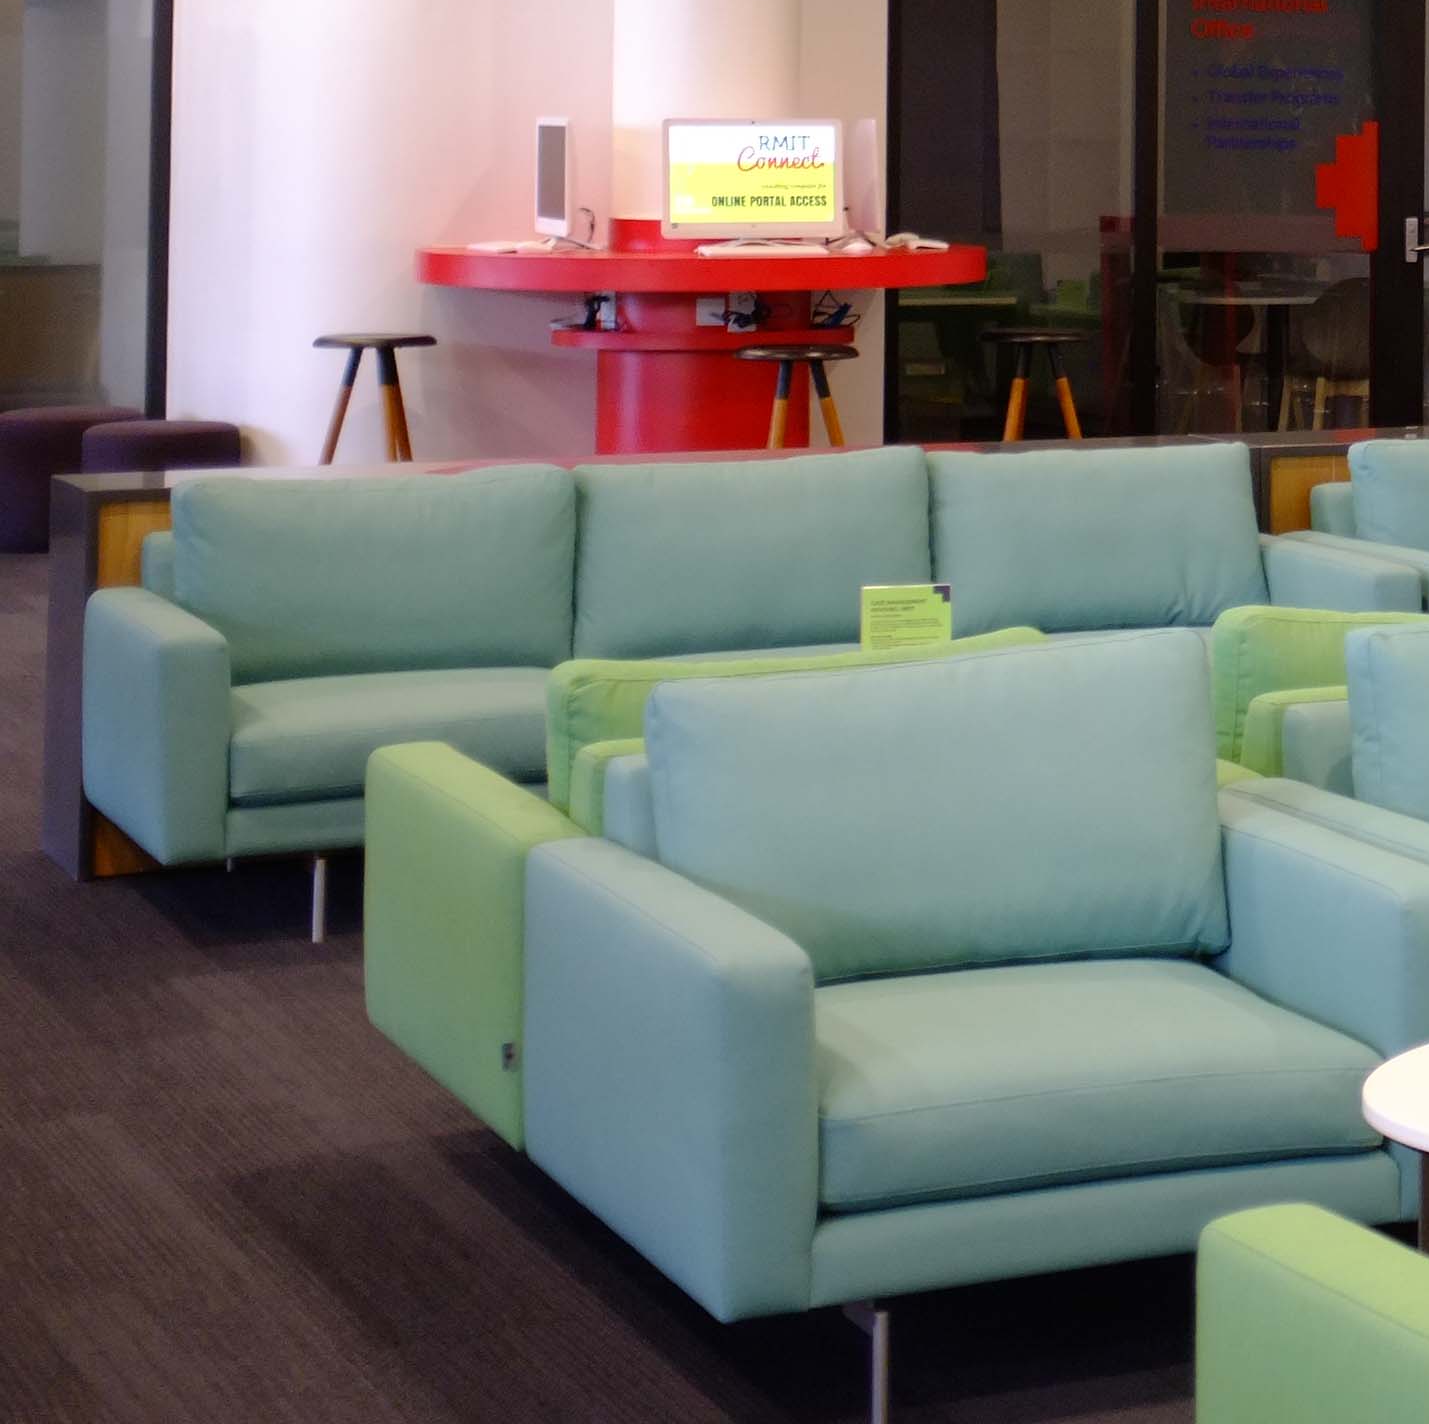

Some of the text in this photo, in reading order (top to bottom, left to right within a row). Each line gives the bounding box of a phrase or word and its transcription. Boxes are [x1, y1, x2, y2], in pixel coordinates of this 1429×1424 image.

[1191, 18, 1255, 40] Office
[759, 135, 810, 151] RMIT
[737, 146, 825, 171] Connect
[711, 195, 827, 207] ONLINE PORTAL ACCESS
